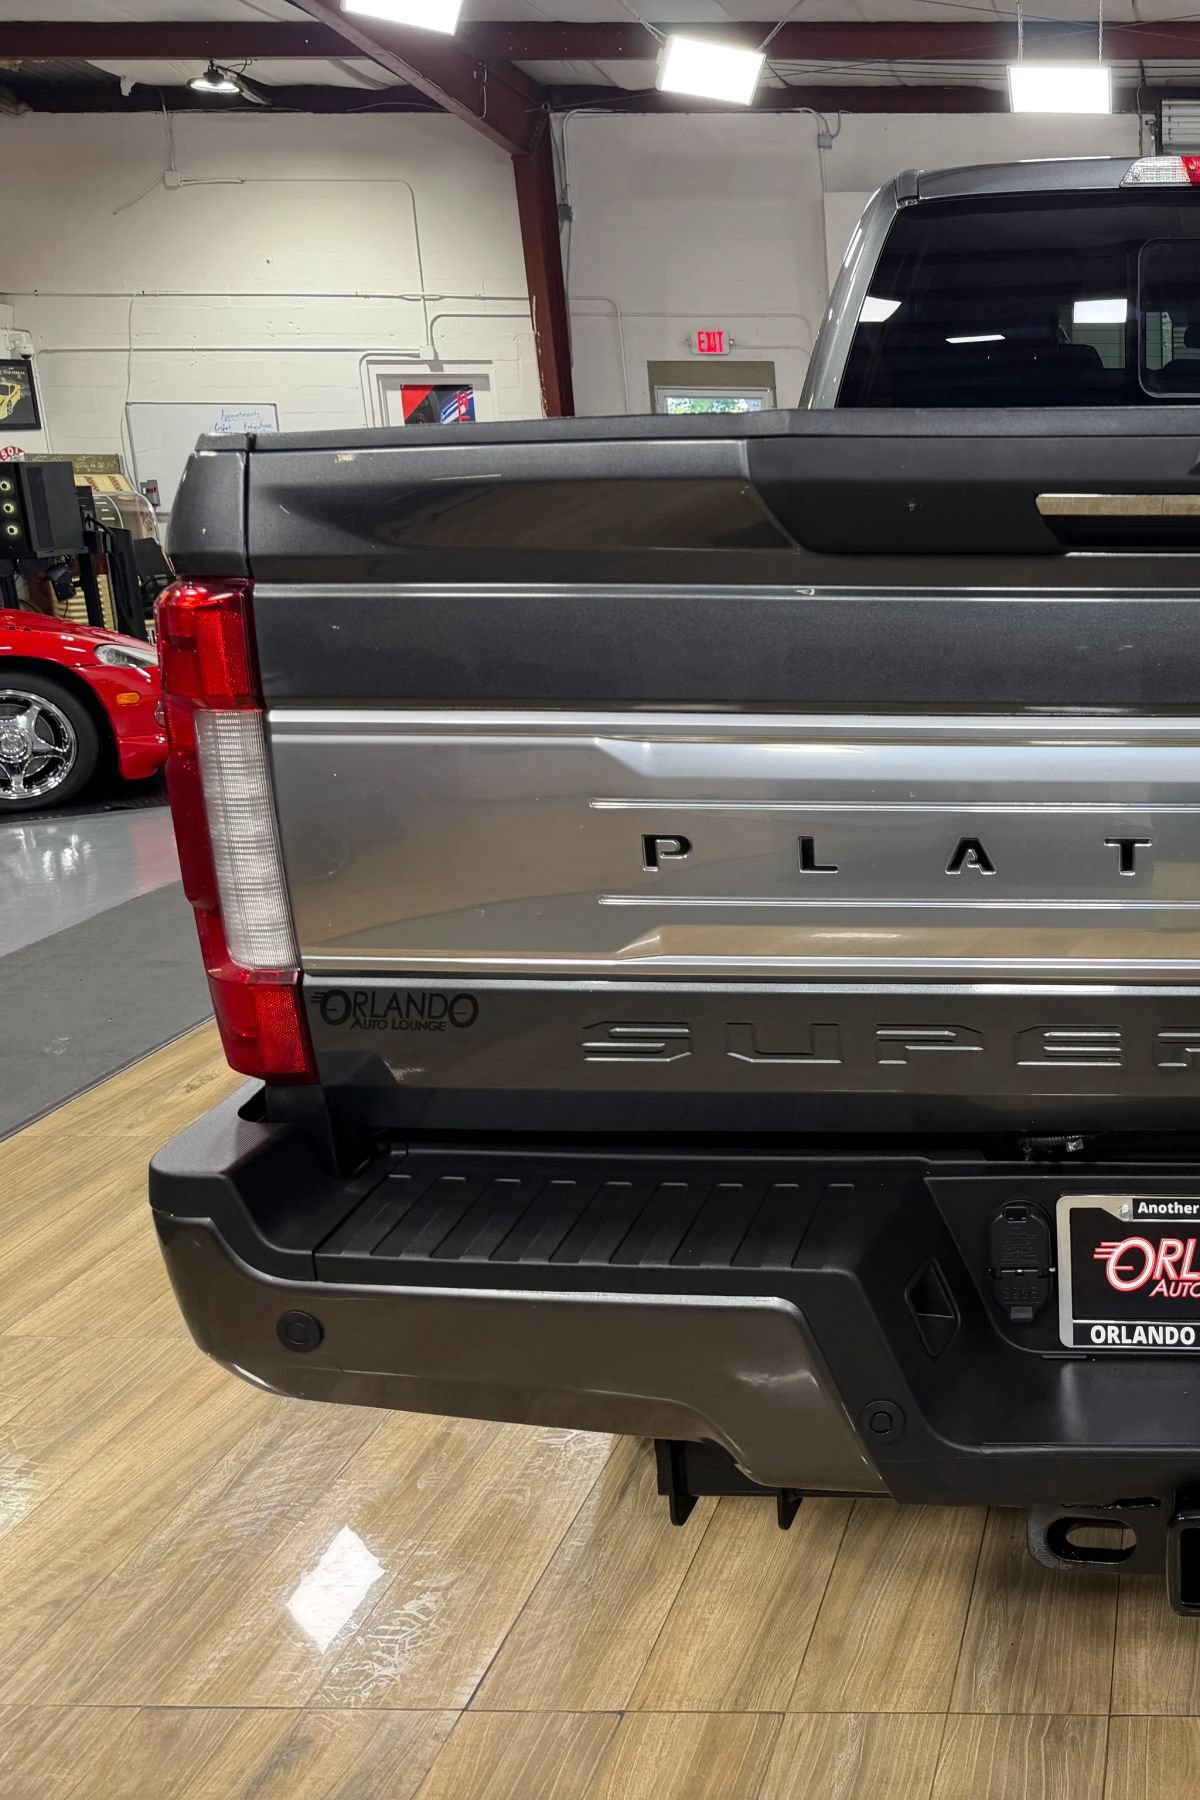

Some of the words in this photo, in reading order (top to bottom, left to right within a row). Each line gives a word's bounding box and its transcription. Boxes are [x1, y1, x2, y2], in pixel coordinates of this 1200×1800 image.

[697, 330, 724, 353] EXIT
[311, 989, 479, 1028] ORLANDO
[350, 1018, 388, 1031] AUTO
[391, 1018, 447, 1031] LOUNGE
[1137, 1201, 1200, 1215] Another
[1090, 1325, 1196, 1346] ORLANDO
